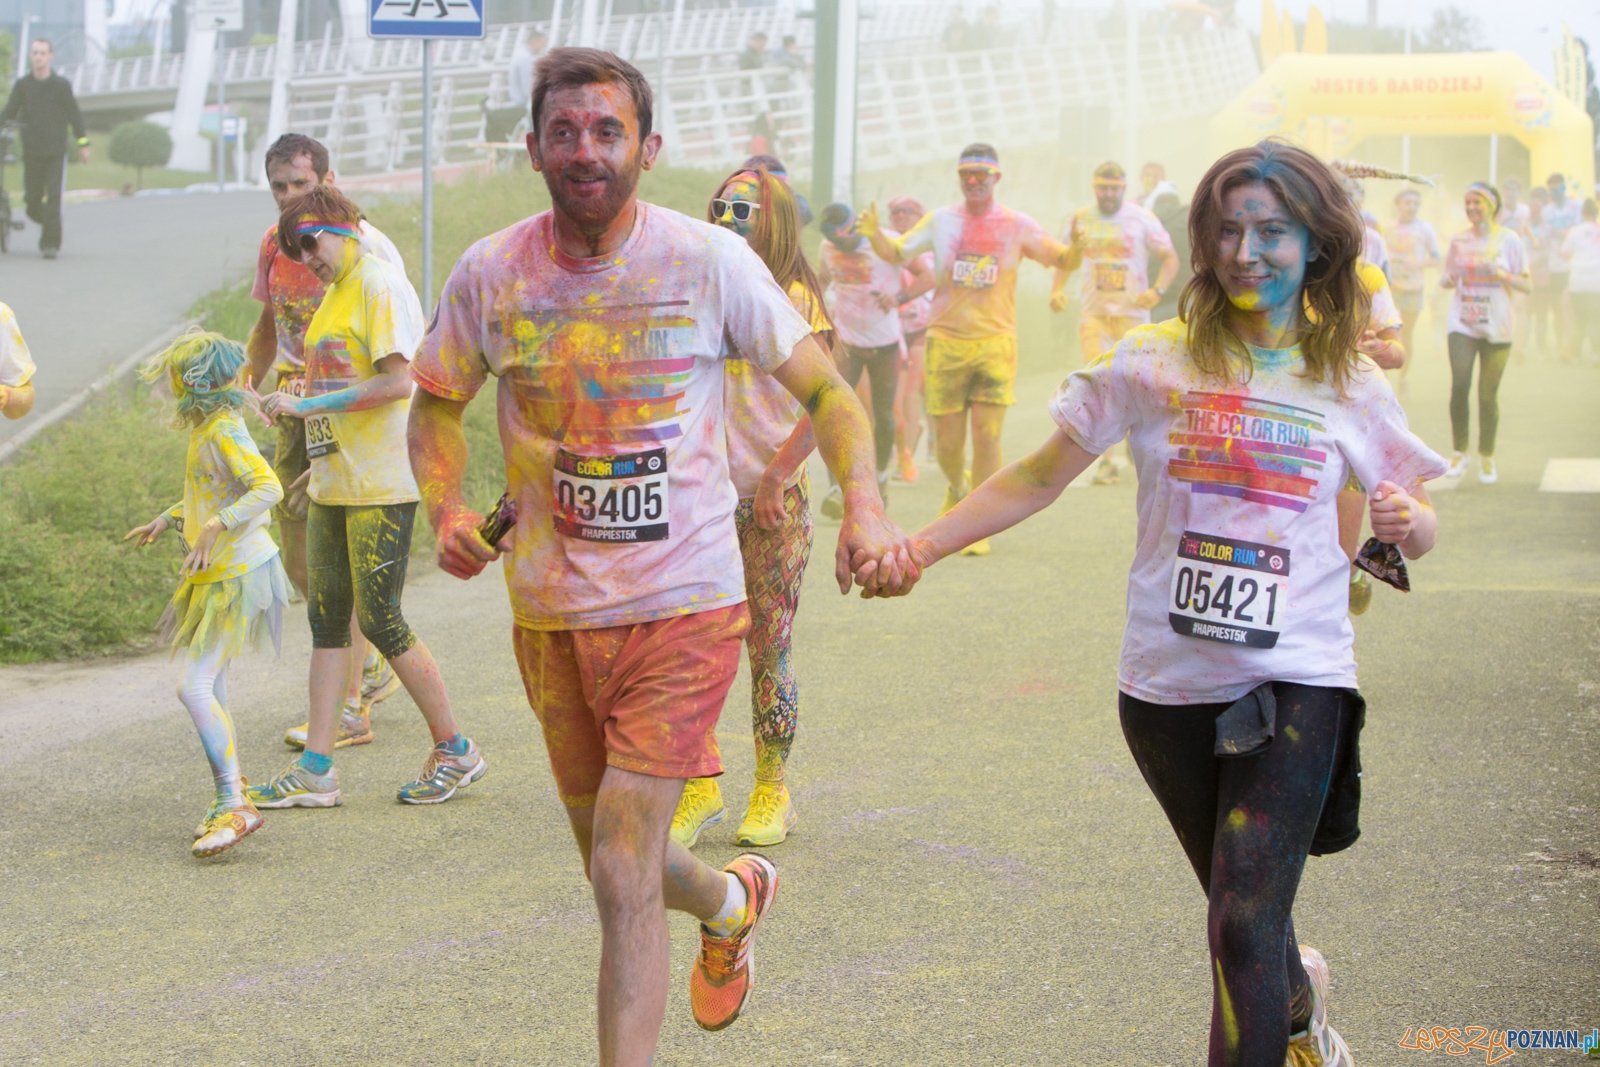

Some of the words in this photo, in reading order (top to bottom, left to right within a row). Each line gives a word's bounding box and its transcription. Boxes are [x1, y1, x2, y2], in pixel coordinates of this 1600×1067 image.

[1386, 76, 1483, 94] BARDZIEJ
[1185, 409, 1216, 433] THE
[1217, 412, 1274, 443] COLOR
[1276, 422, 1311, 448] RUN
[561, 456, 576, 473] THE
[613, 460, 635, 476] RUN
[558, 479, 663, 523] 03405
[581, 528, 637, 541] #HAPPIEST5K
[1184, 538, 1200, 556] THE
[1199, 541, 1233, 562] COLOR
[1233, 547, 1257, 566] RUN
[1174, 566, 1278, 626] 05421
[1192, 621, 1248, 643] #HAPPIEST5K
